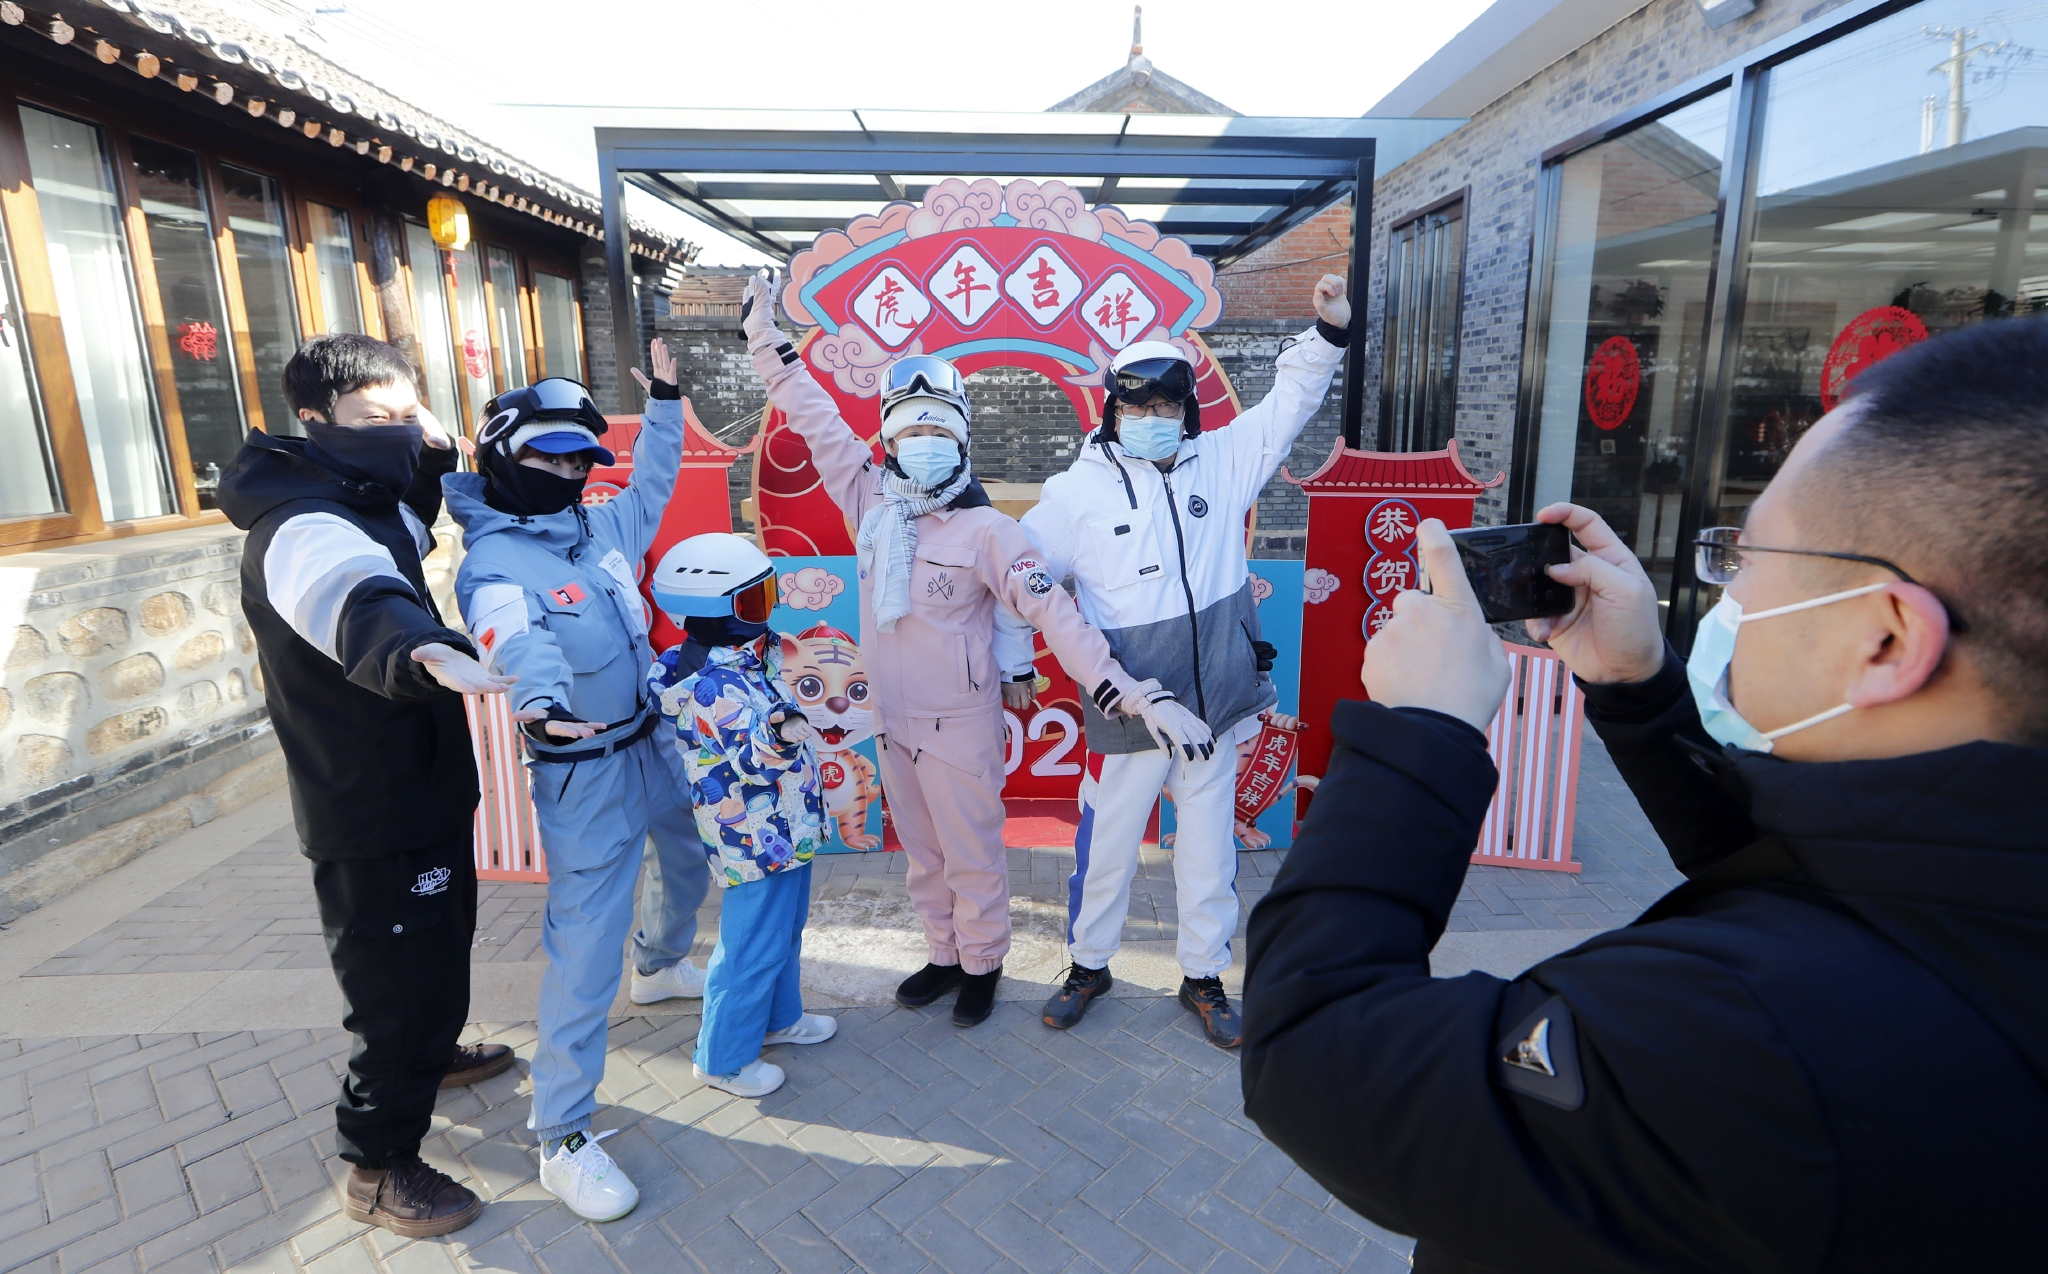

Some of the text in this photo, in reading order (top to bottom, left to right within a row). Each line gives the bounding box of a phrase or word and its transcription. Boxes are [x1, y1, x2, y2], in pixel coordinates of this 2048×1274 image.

[873, 256, 1140, 343] 虎年吉祥
[1011, 560, 1040, 573] NASA
[823, 765, 843, 783] 虎
[1237, 734, 1288, 808] 虎年吉祥
